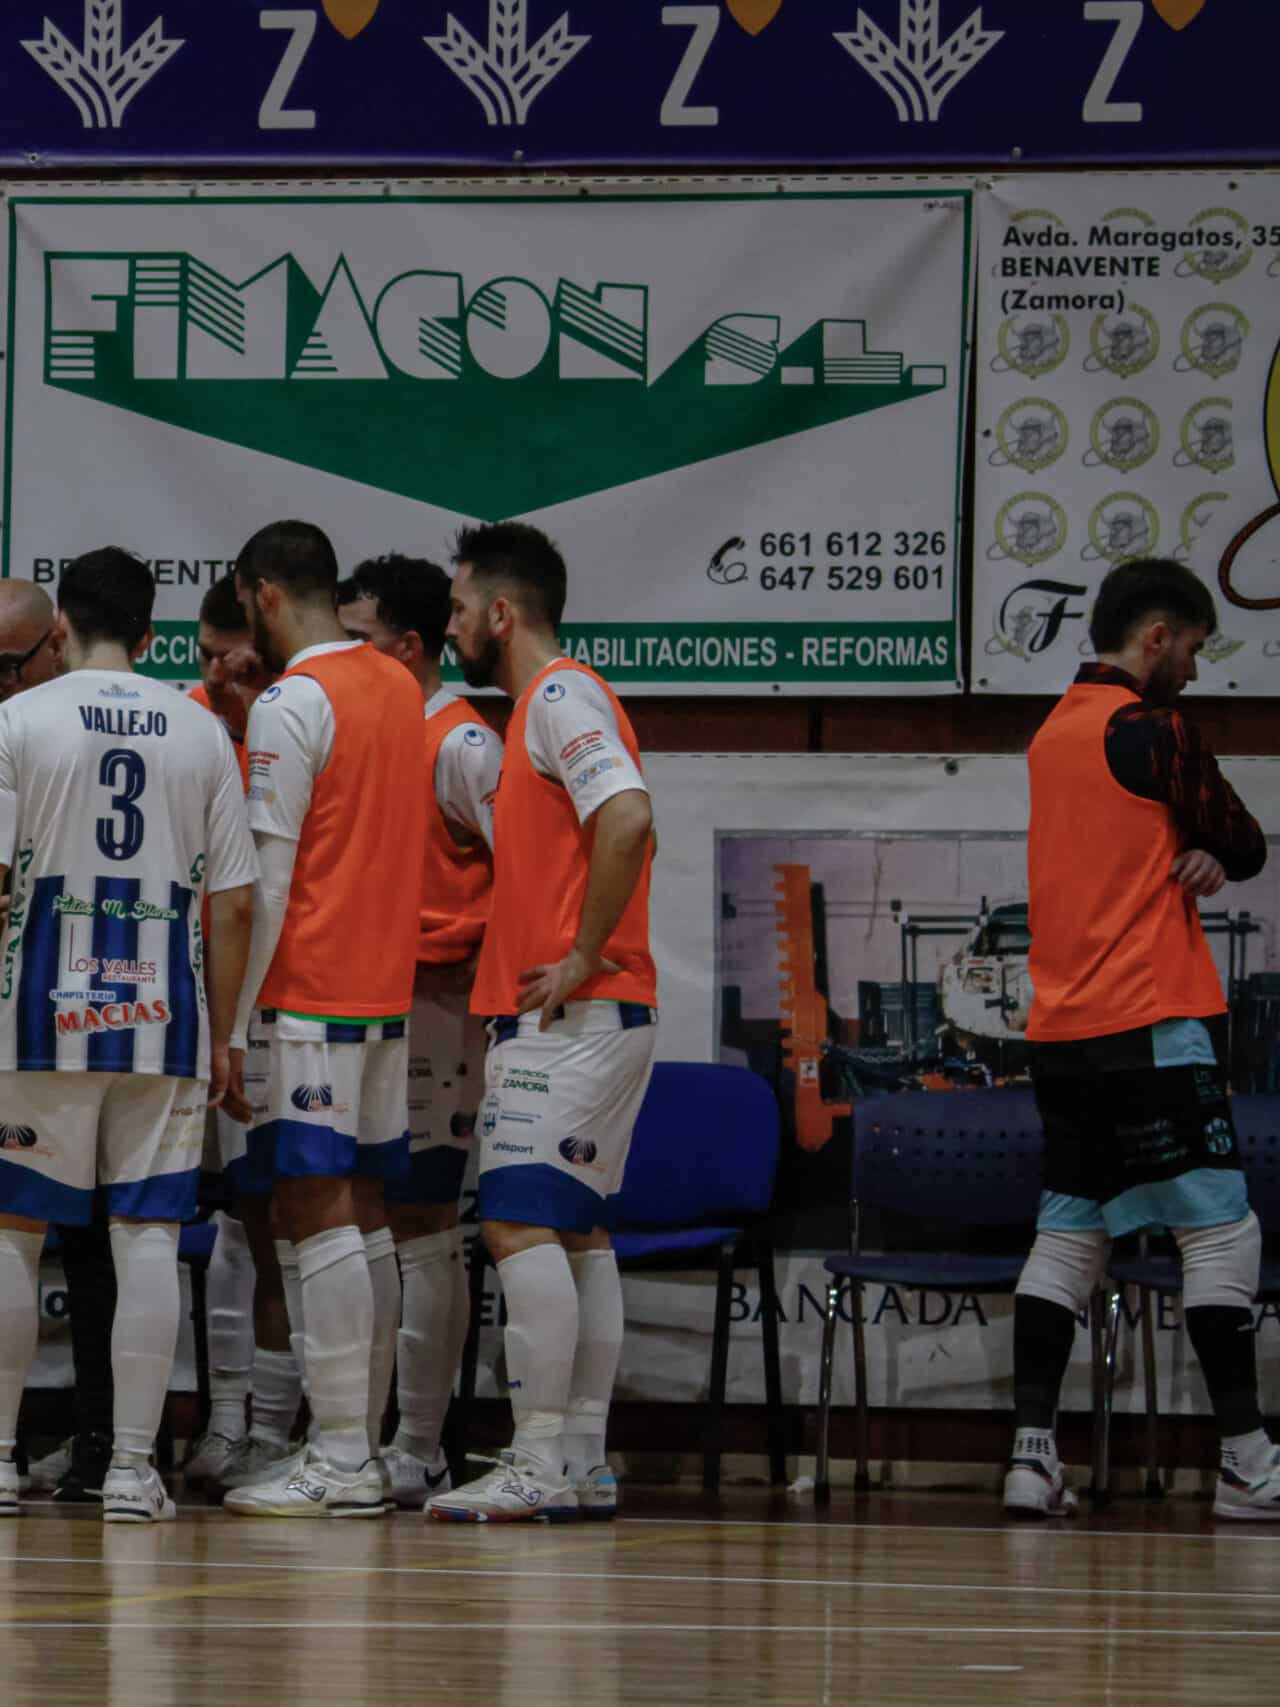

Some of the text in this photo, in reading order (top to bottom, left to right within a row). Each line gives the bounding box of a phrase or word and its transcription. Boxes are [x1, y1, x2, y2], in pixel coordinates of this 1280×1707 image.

[257, 10, 317, 129] Z
[658, 5, 719, 126] Z
[1082, 1, 1143, 123] Z
[1002, 225, 1077, 247] Avda.
[1089, 225, 1241, 251] Maragatos,
[1001, 256, 1160, 278] BENAVENTE
[1001, 289, 1125, 315] (Zamora)
[760, 531, 946, 556] 661 612 326
[760, 565, 944, 590] 647 529 601
[801, 635, 949, 668] REFORMAS
[79, 705, 167, 737] VALLEJO
[96, 749, 146, 861] 3
[102, 959, 157, 976] VALLES
[56, 1000, 169, 1034] MACIAS
